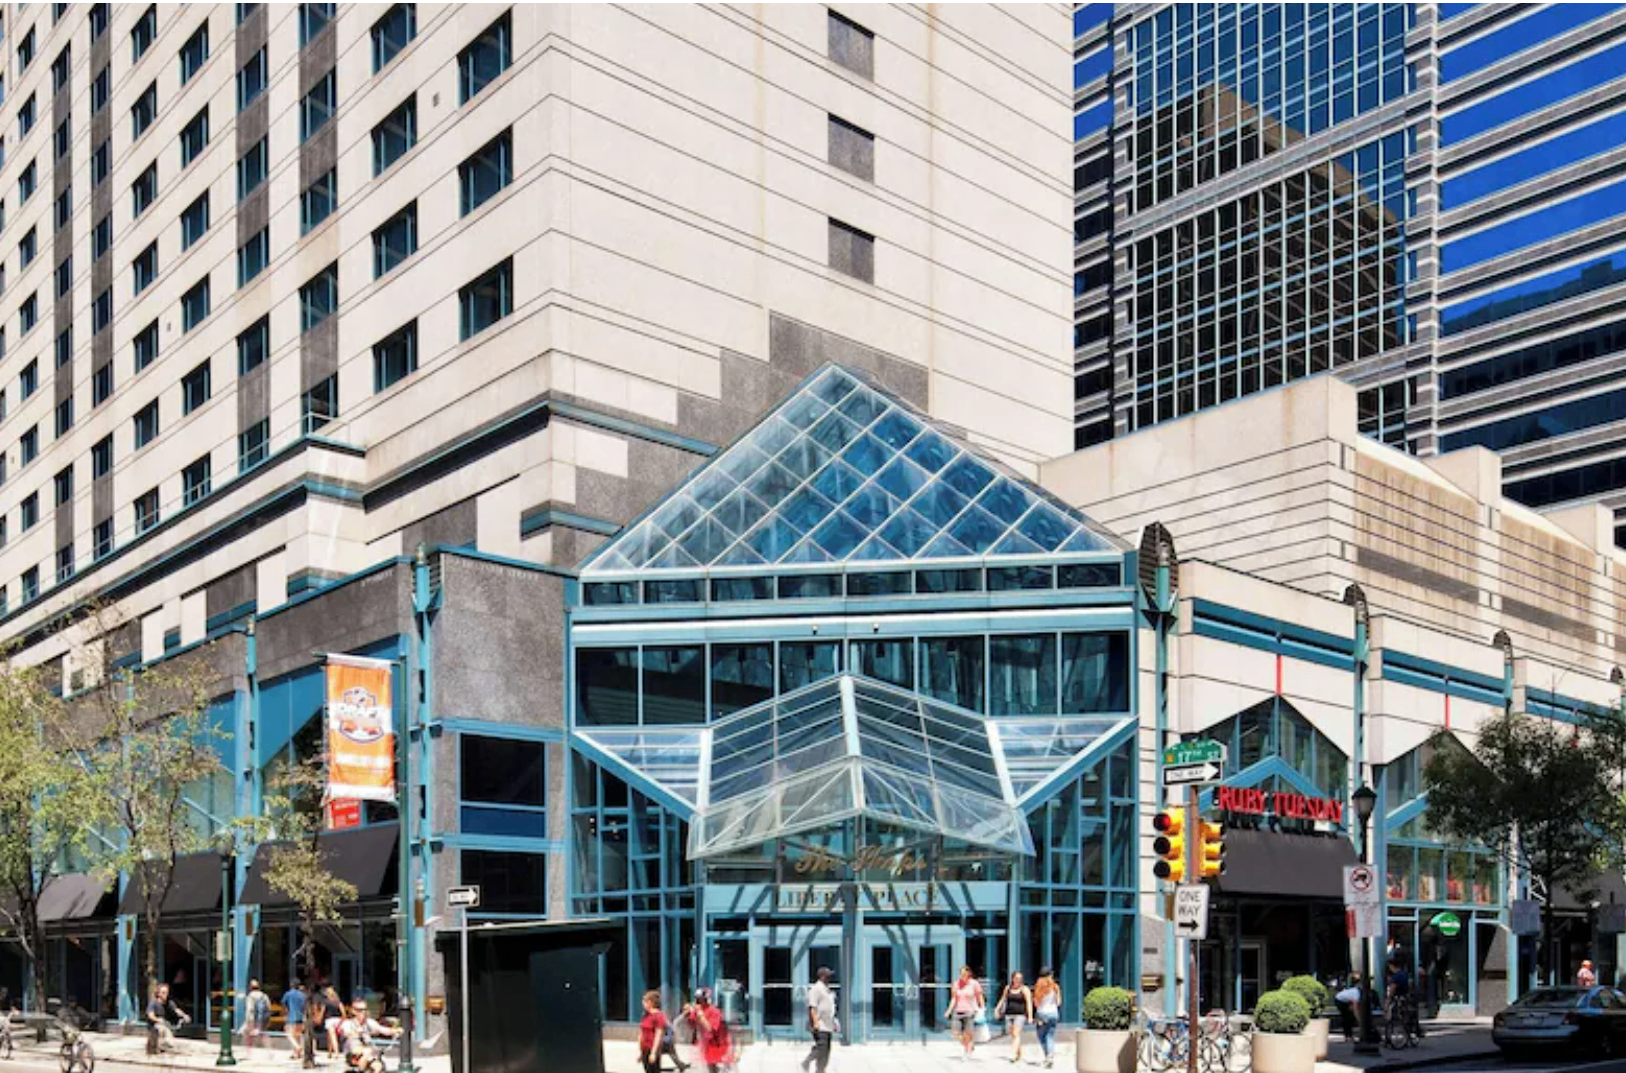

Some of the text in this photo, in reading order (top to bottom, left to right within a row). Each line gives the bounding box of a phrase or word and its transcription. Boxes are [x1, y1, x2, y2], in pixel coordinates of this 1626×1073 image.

[1219, 784, 1343, 824] RUBY TUESDAY
[1179, 890, 1201, 903] ONE
[1178, 904, 1201, 918] WAY
